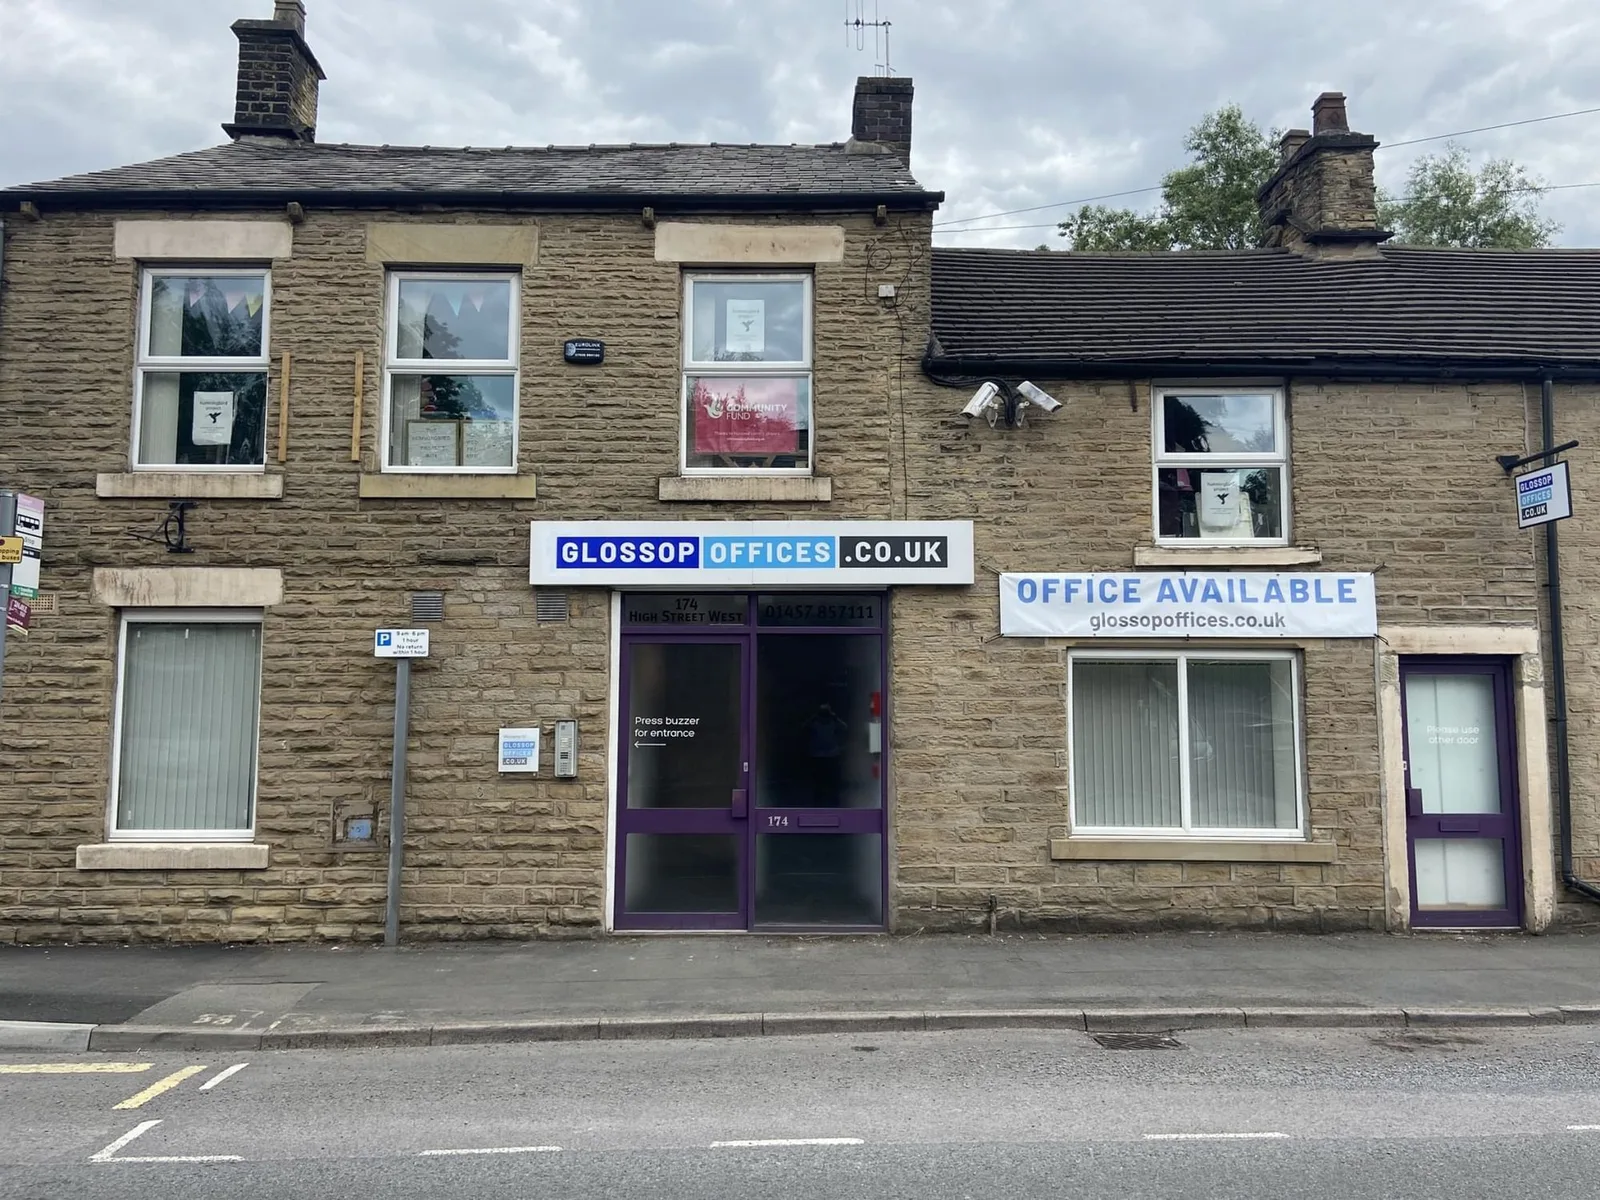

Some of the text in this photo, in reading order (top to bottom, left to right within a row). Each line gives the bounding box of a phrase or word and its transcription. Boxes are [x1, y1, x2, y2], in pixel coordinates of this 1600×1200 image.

[726, 403, 788, 412] COMMUNITY
[726, 412, 751, 420] FUND
[1519, 475, 1553, 493] GLOSSOP
[1521, 489, 1552, 506] OFFICES
[1522, 504, 1547, 519] .CO.UK
[561, 540, 942, 563] GLOSSOP OFFICES .CO.UK
[1017, 578, 1358, 604] OFFICE AVAILABLE
[675, 597, 698, 611] 174
[765, 604, 814, 619] 01457
[1089, 611, 1287, 631] glossopoffices.co.uk
[379, 633, 390, 646] P
[634, 716, 700, 725] Press buzzer
[634, 728, 695, 738] for entrance
[1426, 725, 1480, 734] Please use
[1428, 736, 1479, 745] other door
[767, 815, 789, 827] 174
